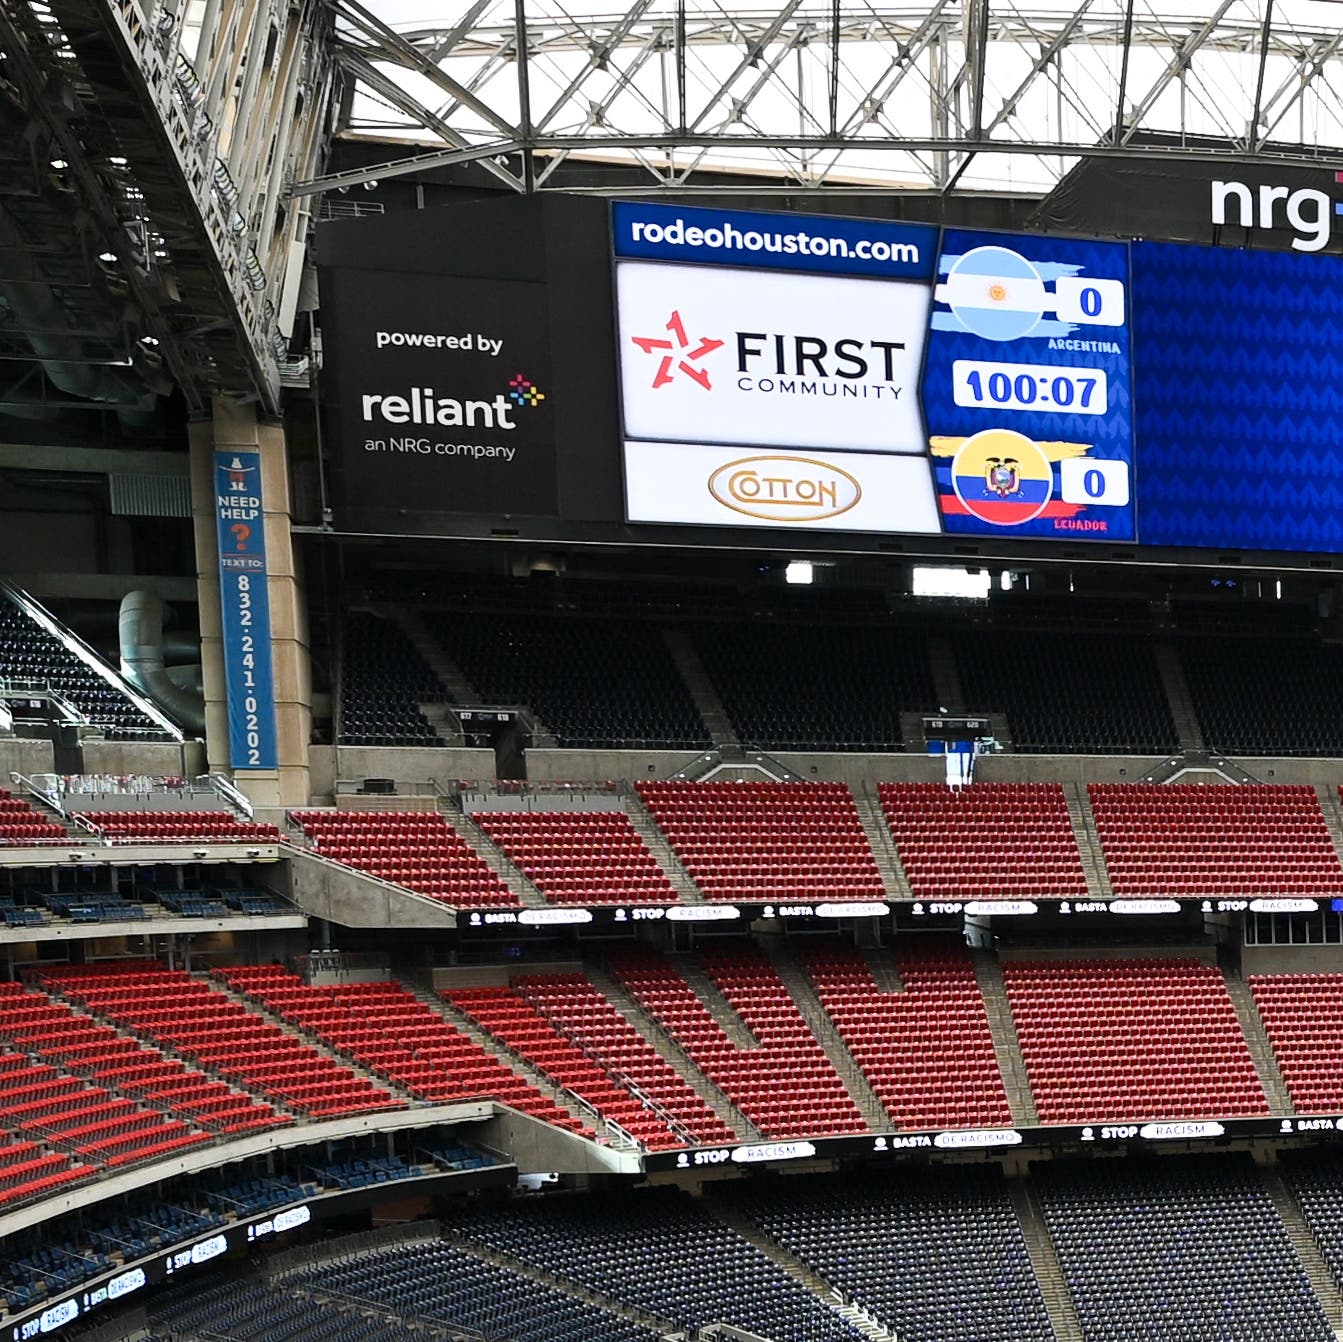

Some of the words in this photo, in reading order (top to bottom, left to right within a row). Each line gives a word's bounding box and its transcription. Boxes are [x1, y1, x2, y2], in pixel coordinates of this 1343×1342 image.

[1211, 180, 1331, 252] nrg
[631, 218, 920, 264] rodeohouston.com
[1080, 287, 1102, 317] 0
[376, 330, 473, 350] powered
[477, 334, 503, 356] by
[1047, 338, 1121, 355] ARGENTINA
[735, 331, 906, 382] FIRST
[737, 377, 902, 401] COMMUNITY
[966, 370, 1098, 410] 100:07
[362, 387, 517, 430] reliant
[364, 439, 387, 452] an
[390, 437, 431, 454] NRG
[434, 442, 516, 462] company
[1083, 469, 1106, 498] 0
[218, 495, 260, 508] NEED
[220, 508, 260, 521] HELP
[1053, 518, 1108, 532] ECUADOR
[222, 559, 247, 568] TEXT
[484, 912, 518, 924] BASTA
[632, 907, 666, 921] STOP
[679, 907, 723, 920] RACISM
[1101, 1126, 1138, 1140] STOP
[1156, 1125, 1206, 1138] RACISM
[1298, 1118, 1335, 1132] BASTA
[893, 1136, 933, 1152] BASTA
[942, 1135, 956, 1148] DE
[960, 1132, 1016, 1146] RACISMO
[694, 1149, 731, 1166] STOP
[747, 1145, 797, 1160] RACISM
[21, 1317, 40, 1341] STOP
